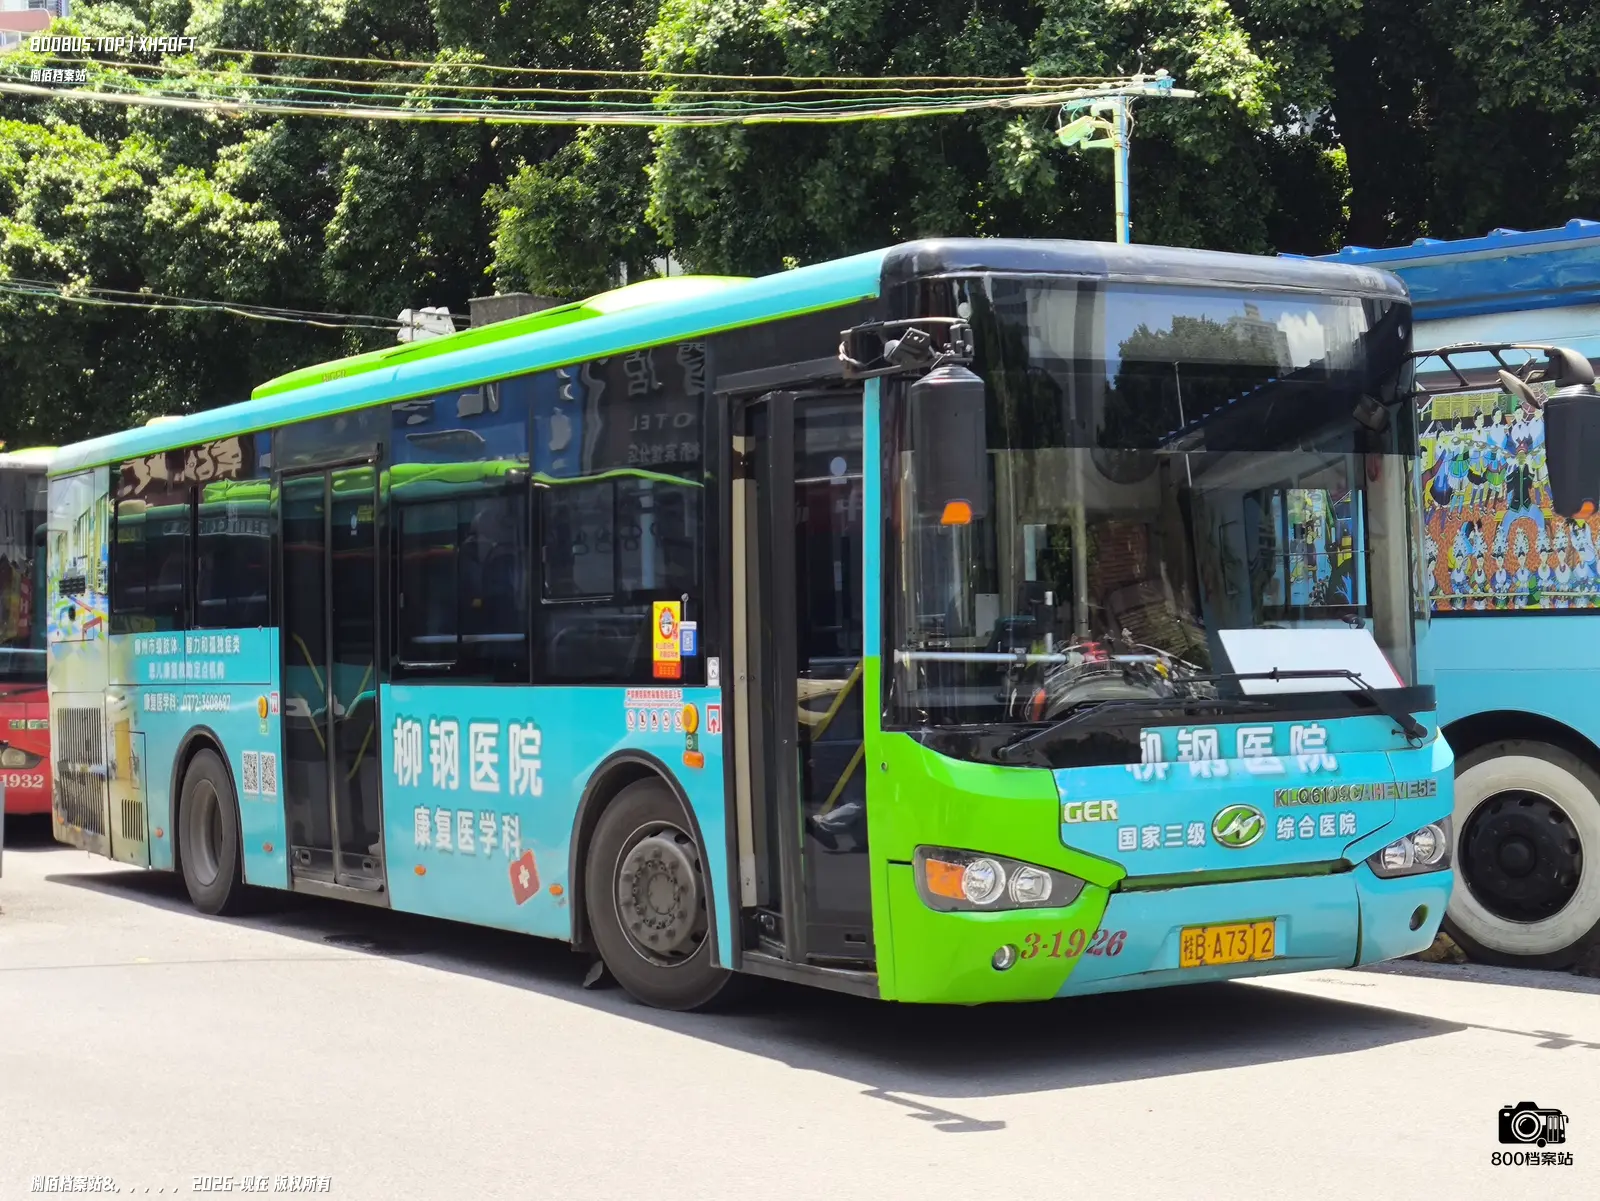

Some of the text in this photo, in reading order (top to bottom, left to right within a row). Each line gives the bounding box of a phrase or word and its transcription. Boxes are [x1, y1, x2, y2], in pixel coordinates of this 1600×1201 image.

[392, 716, 543, 798] 柳钢医院
[1063, 799, 1119, 824] GER
[1276, 811, 1357, 842] 综合医院
[413, 804, 522, 859] 康复医学科
[1117, 822, 1207, 852] 国家三级
[1020, 928, 1128, 960] 3-1926
